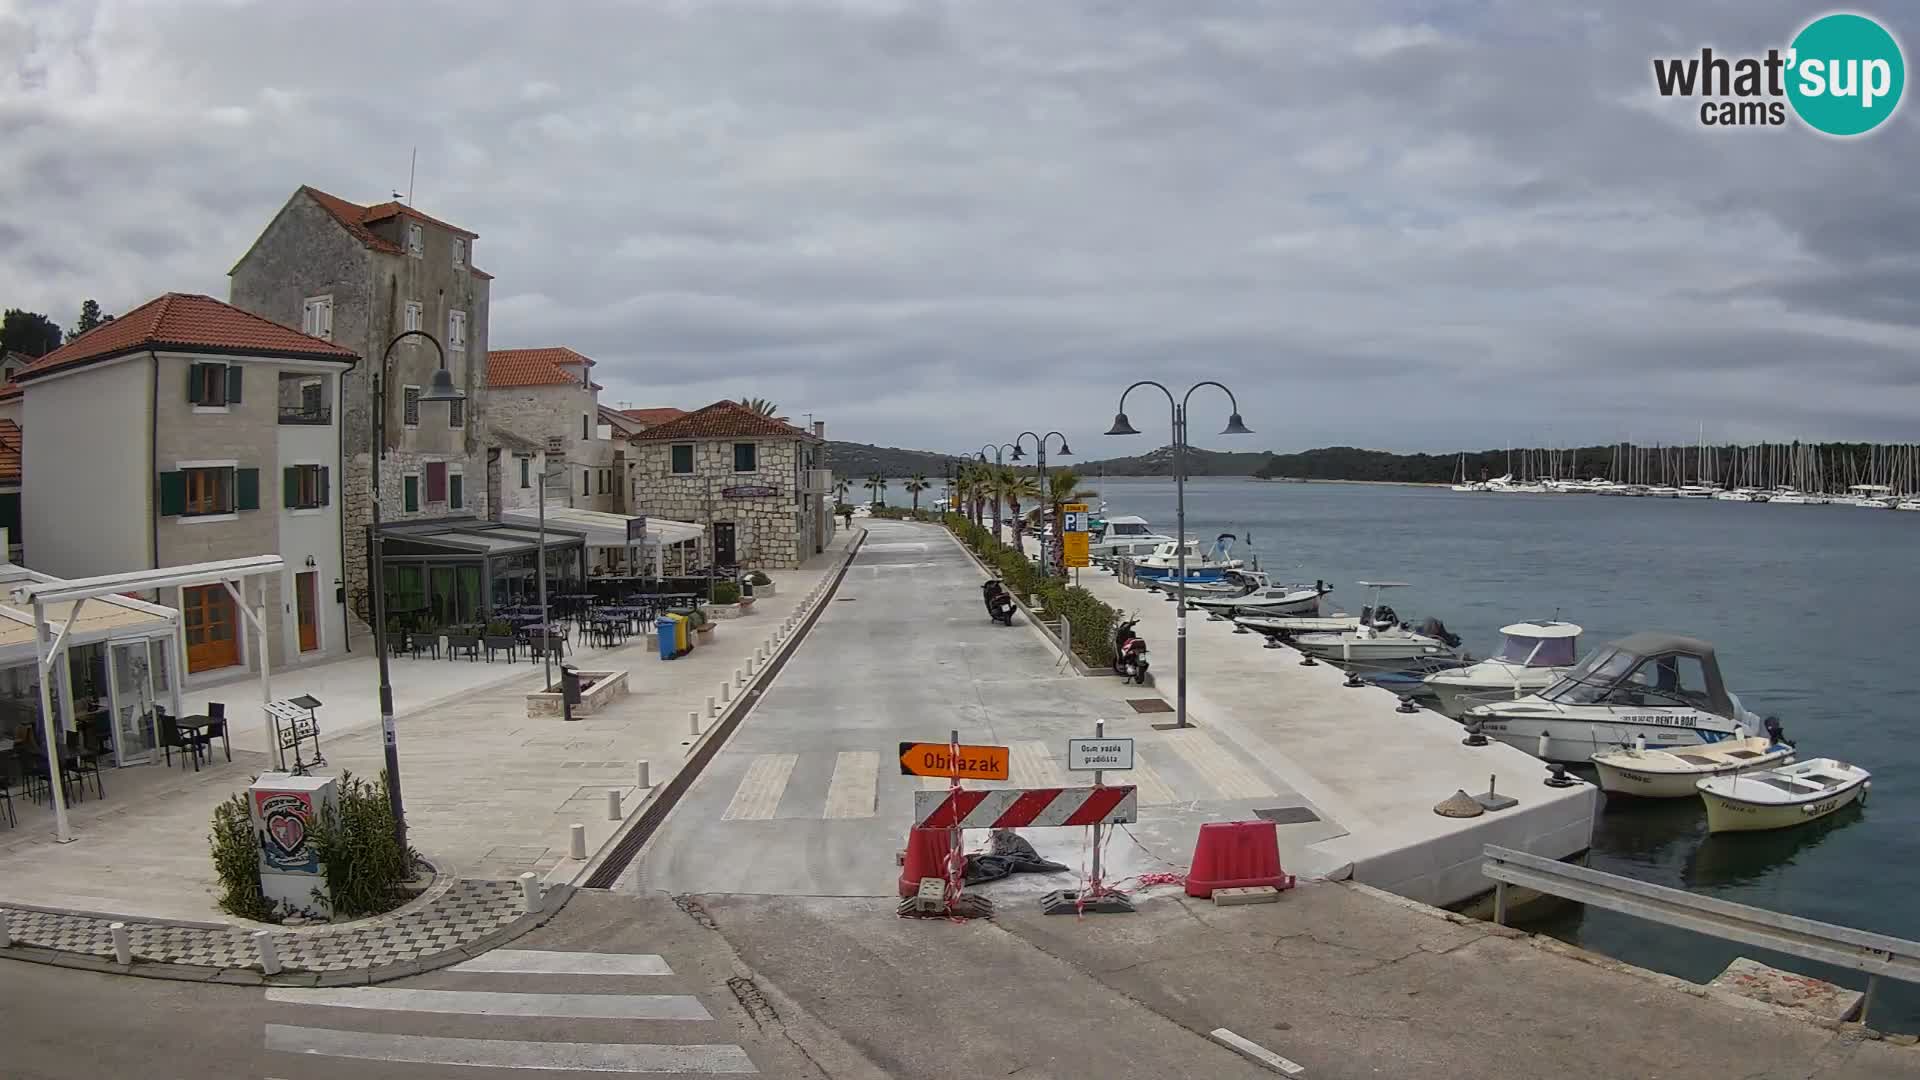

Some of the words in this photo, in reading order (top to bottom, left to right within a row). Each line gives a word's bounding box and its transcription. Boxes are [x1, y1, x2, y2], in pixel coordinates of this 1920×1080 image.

[1655, 715, 1674, 726] RENT
[1674, 715, 1680, 726] A
[1680, 716, 1698, 727] BOAT
[924, 752, 1000, 772] Obilazak
